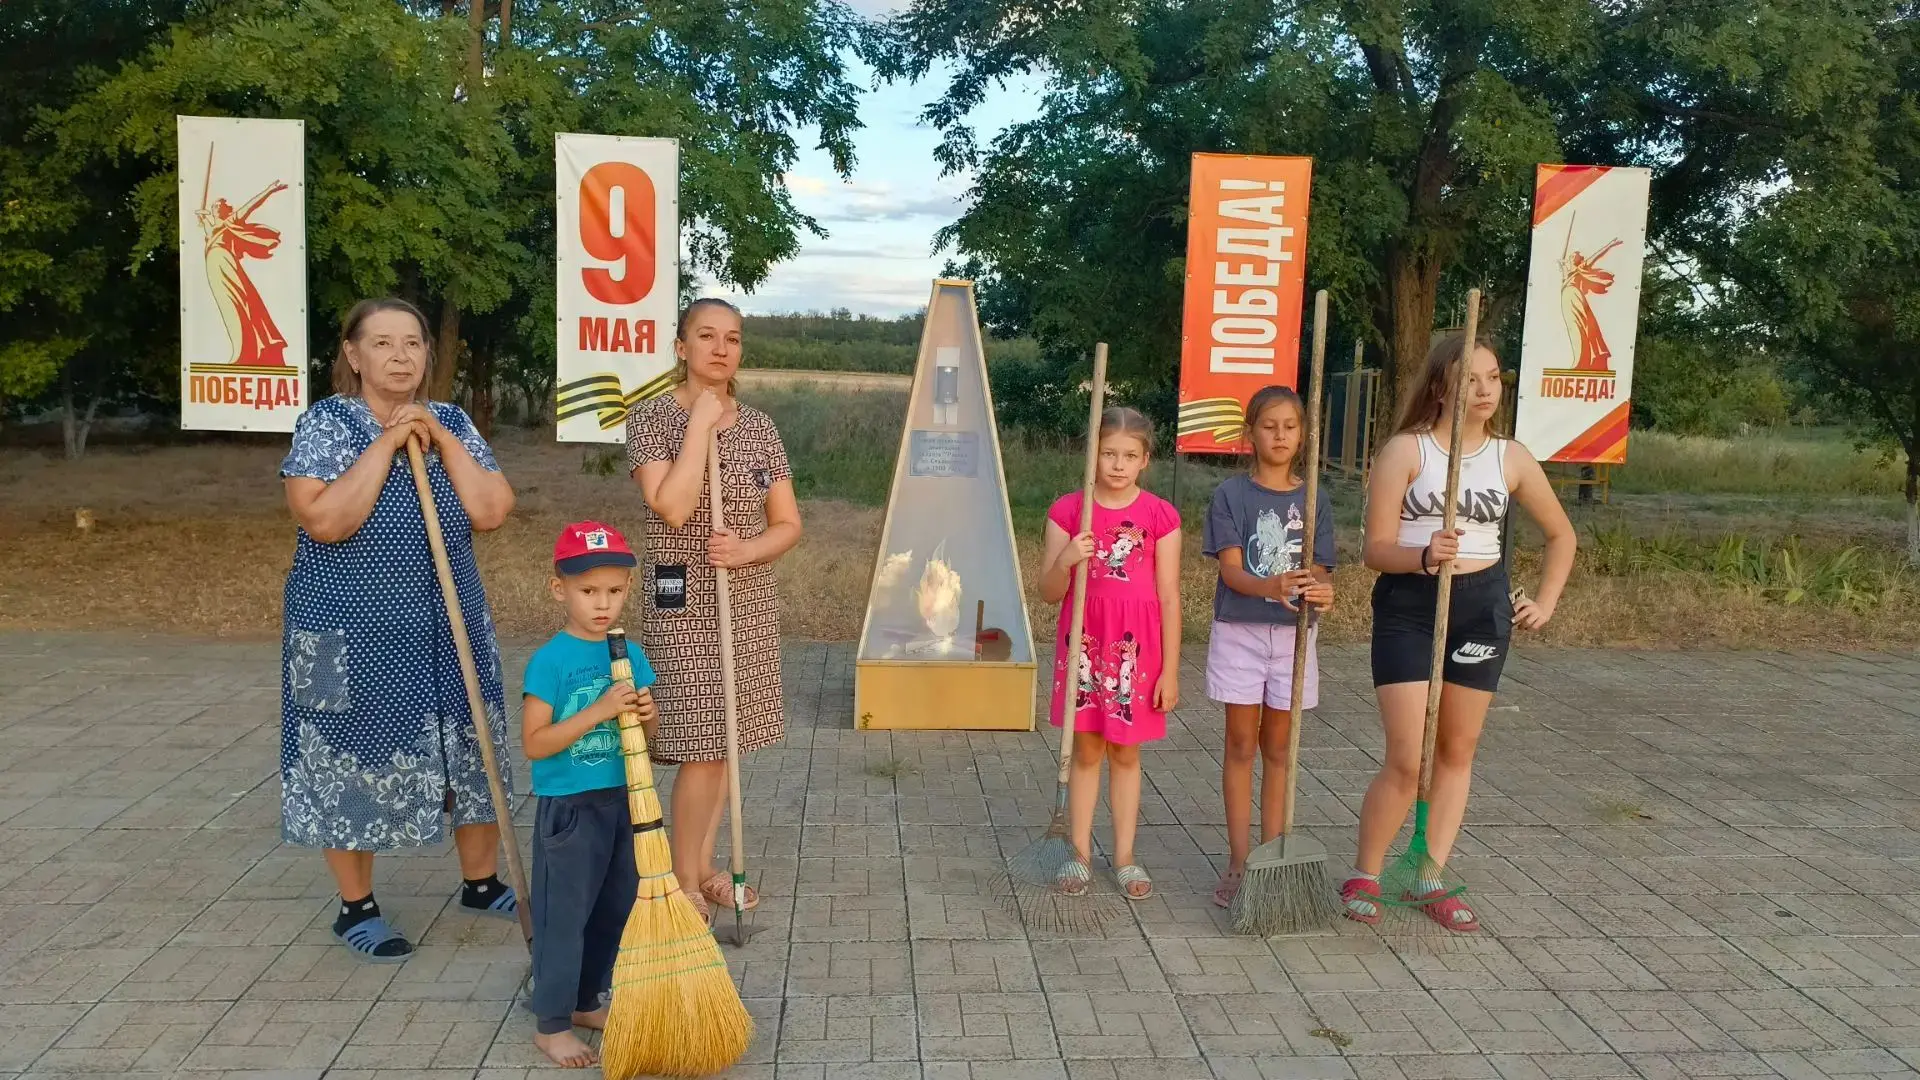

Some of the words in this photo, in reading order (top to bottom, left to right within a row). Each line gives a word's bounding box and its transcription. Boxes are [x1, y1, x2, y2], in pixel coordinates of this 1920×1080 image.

[579, 162, 656, 305] 9
[1210, 179, 1294, 375] ПОБЕДА!
[579, 317, 656, 354] МАЯ
[190, 375, 299, 410] ПОБЕДА!
[1540, 377, 1615, 402] ПОБЕДА!
[1459, 642, 1496, 657] NIKE
